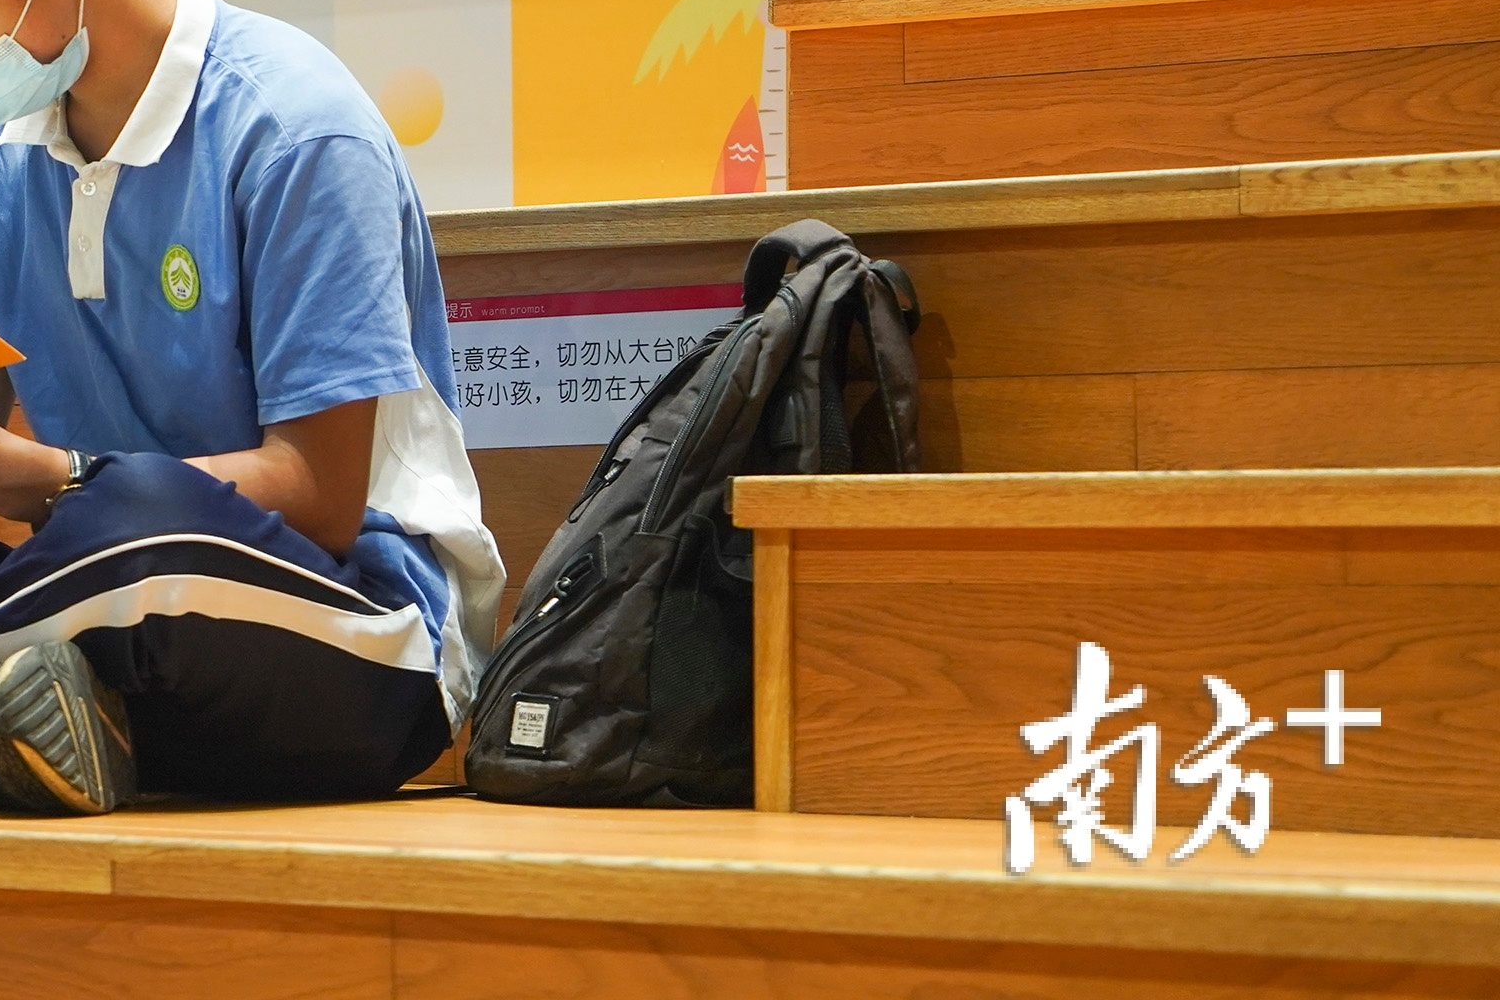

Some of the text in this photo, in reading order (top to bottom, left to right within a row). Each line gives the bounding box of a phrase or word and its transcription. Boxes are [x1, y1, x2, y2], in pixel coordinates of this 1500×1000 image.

[482, 307, 508, 317] warm
[510, 304, 546, 316] prompt
[457, 374, 666, 408] 好小孩，切勿在大
